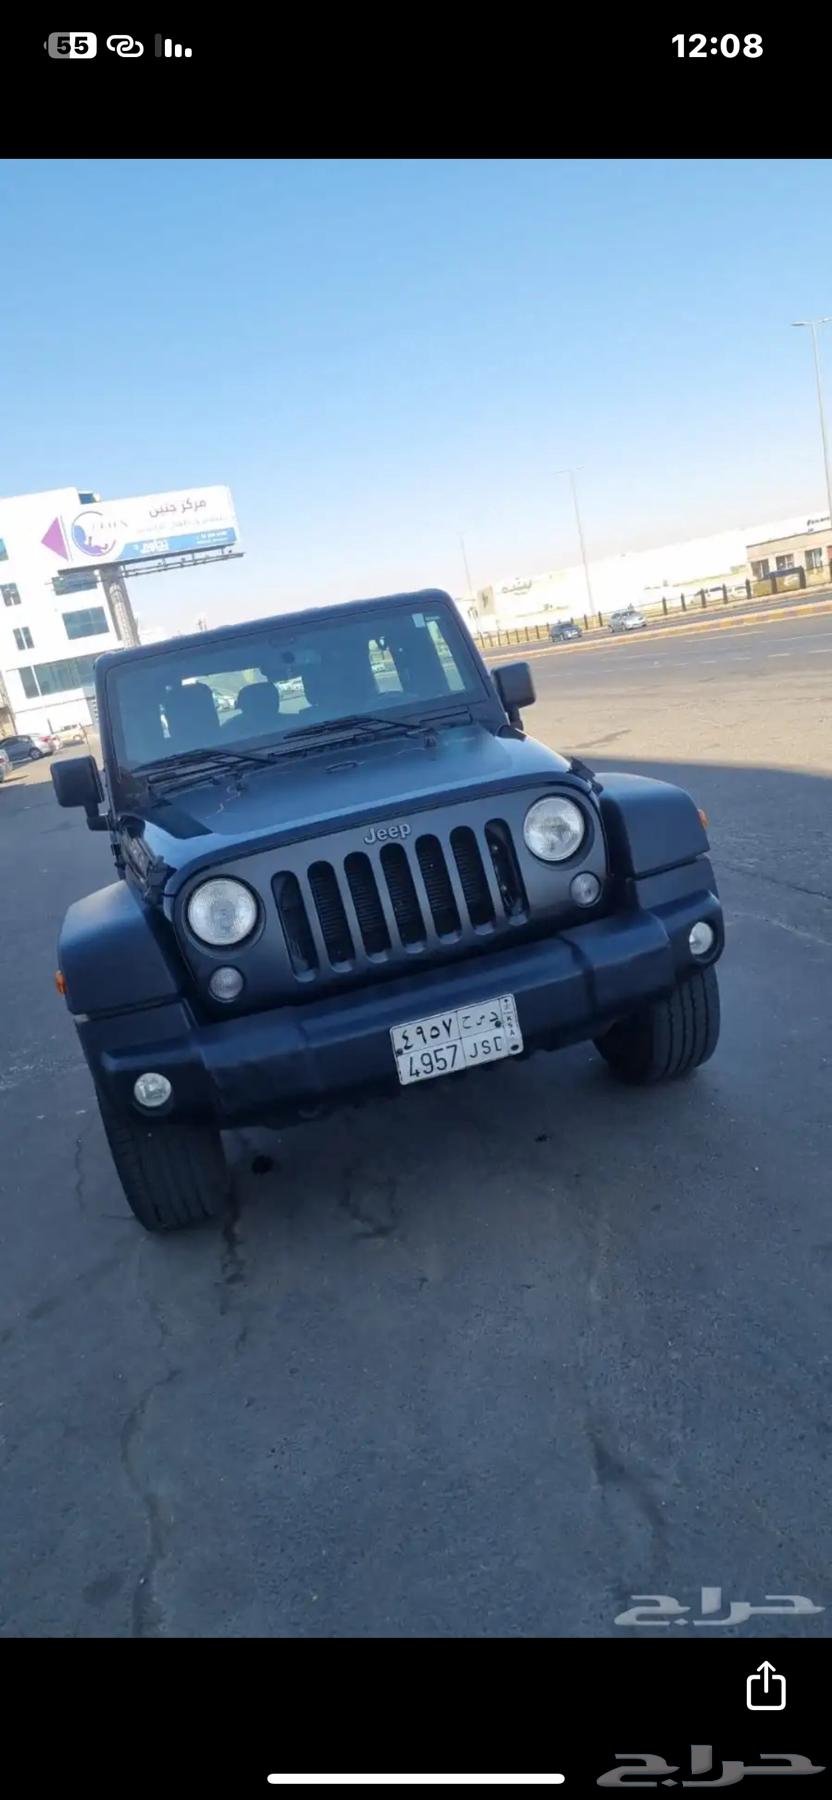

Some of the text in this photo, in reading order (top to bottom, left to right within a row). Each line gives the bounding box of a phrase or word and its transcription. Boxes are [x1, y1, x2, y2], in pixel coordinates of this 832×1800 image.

[364, 823, 411, 844] Jeep
[401, 1018, 453, 1050] ٤٩٥٧
[408, 1044, 458, 1078] 4957
